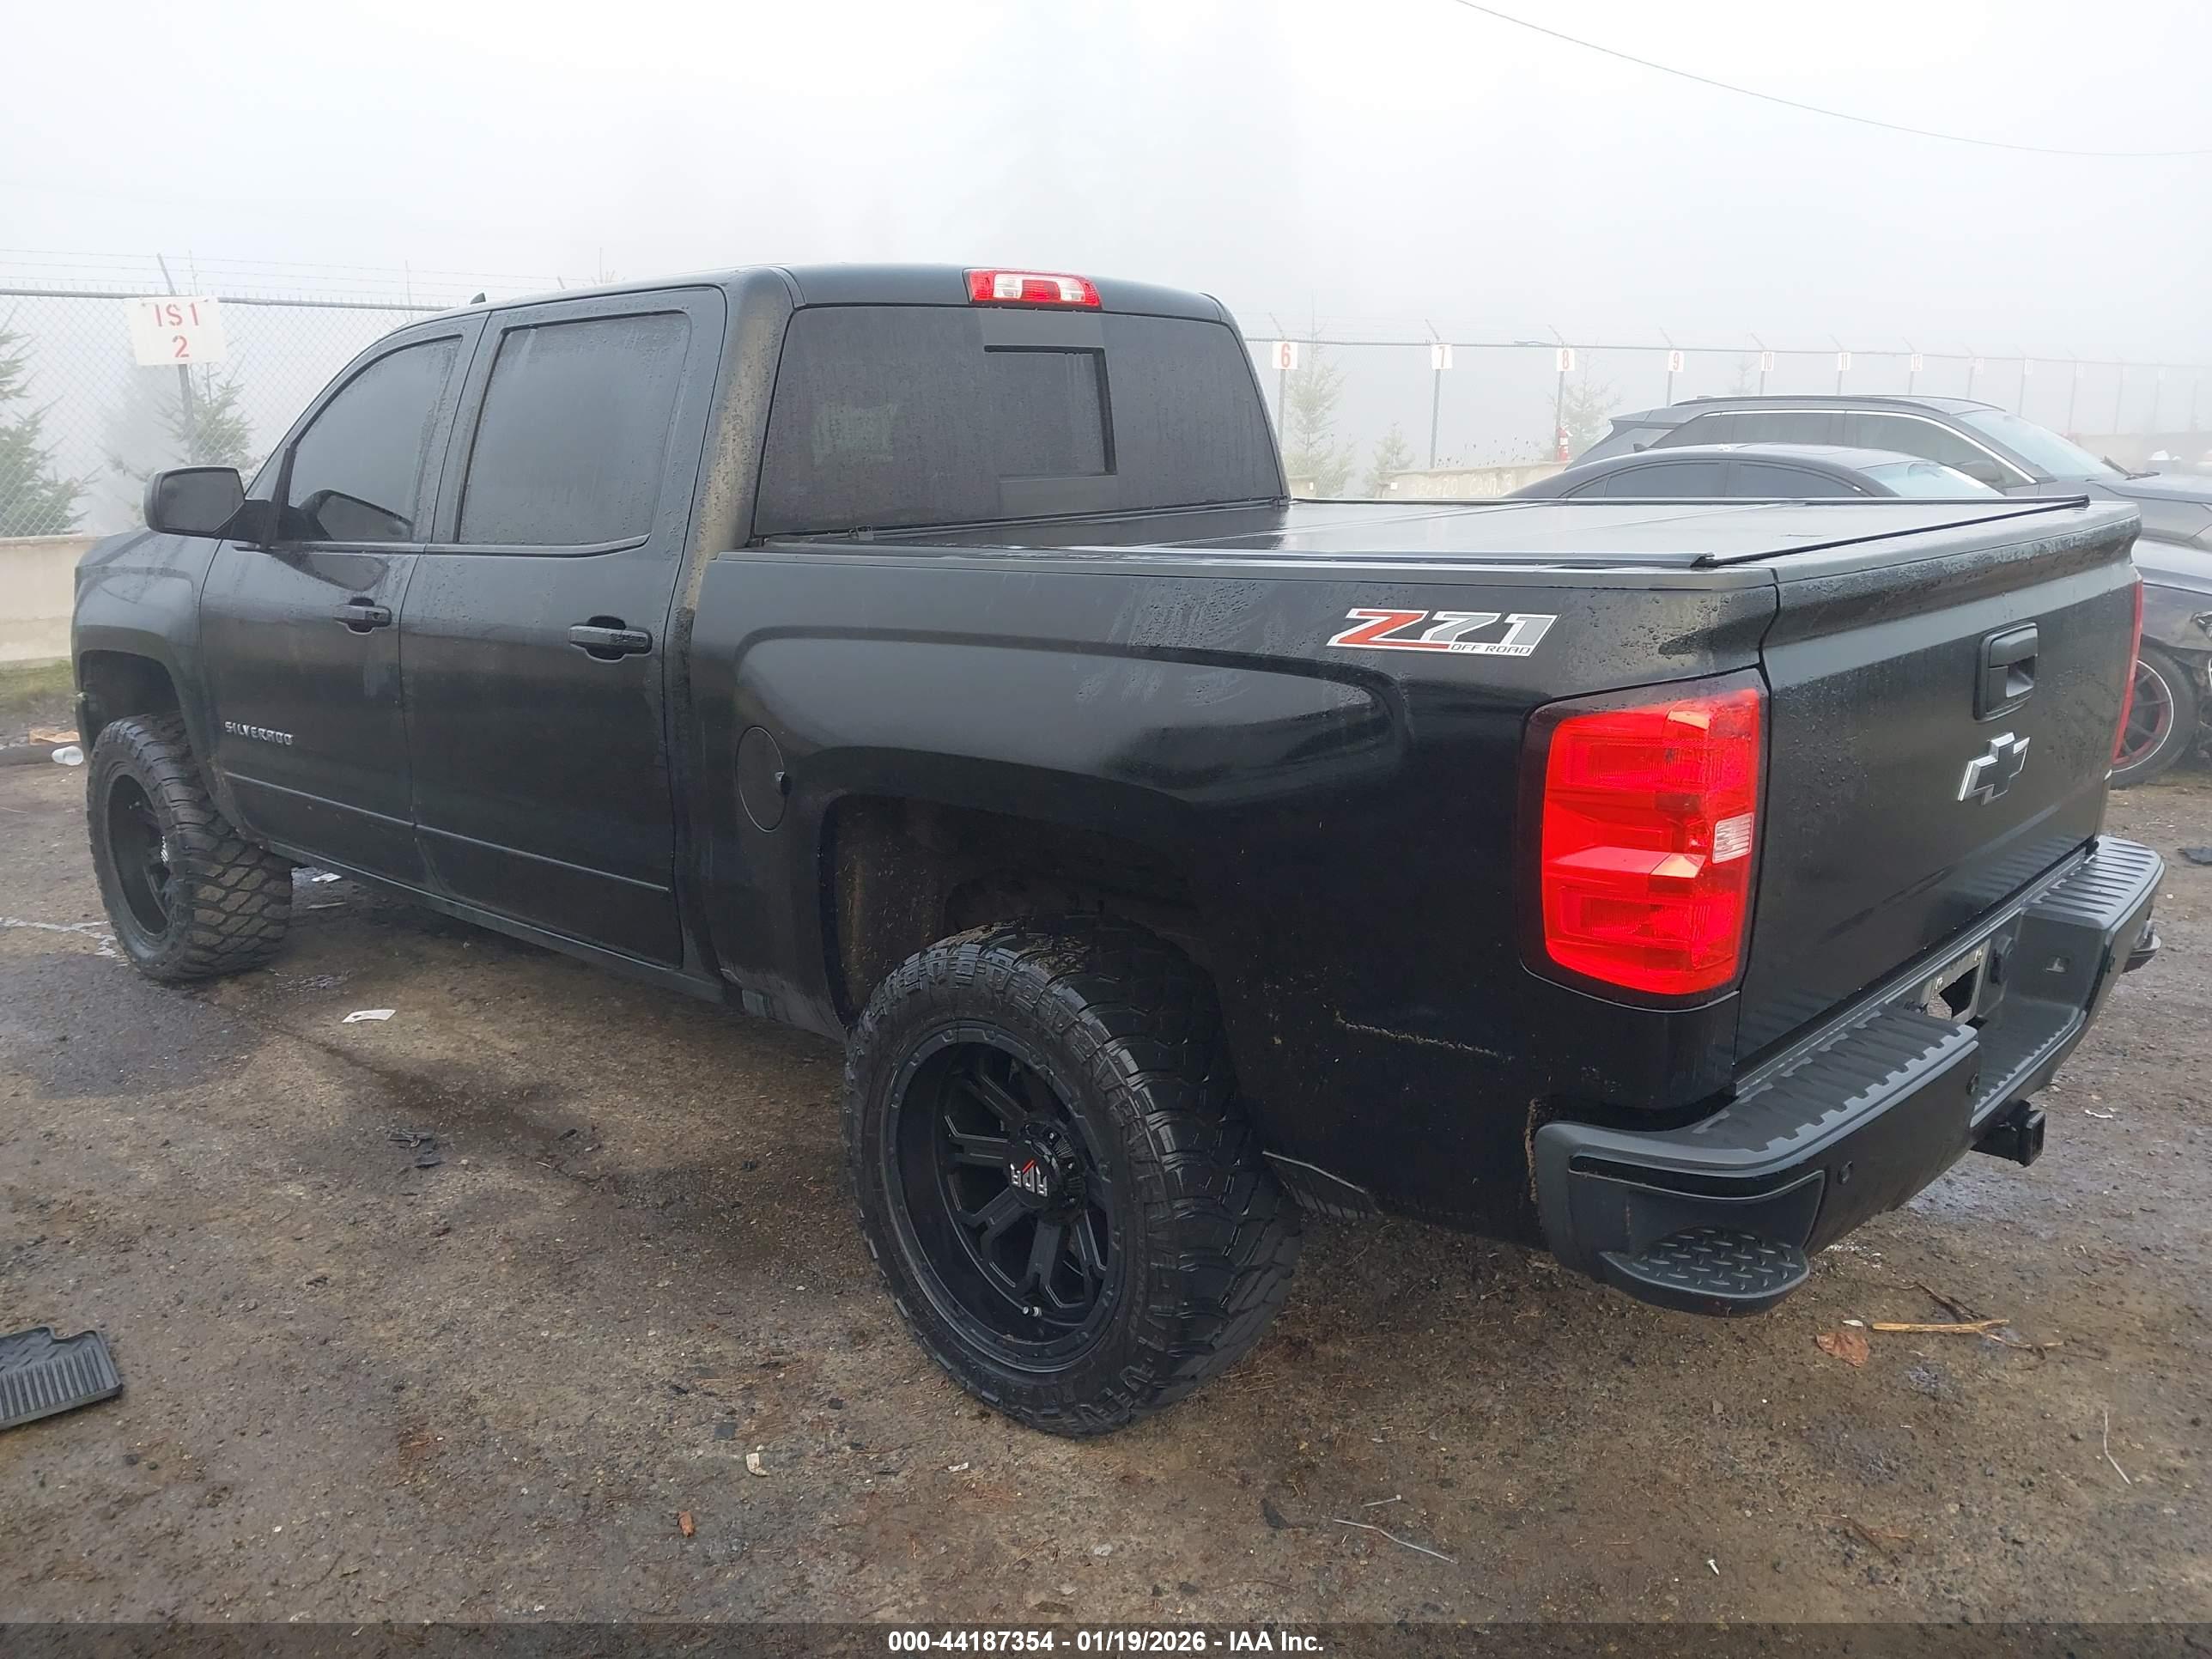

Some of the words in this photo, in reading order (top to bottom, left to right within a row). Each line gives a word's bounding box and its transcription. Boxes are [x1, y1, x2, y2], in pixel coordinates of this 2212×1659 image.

[172, 335, 190, 358] 2
[1280, 343, 1291, 368] 6
[1438, 345, 1446, 368] 7
[1562, 349, 1570, 370] 8
[1673, 352, 1680, 371] 9
[1763, 353, 1773, 370] 10
[1840, 354, 1848, 370] 11
[1326, 607, 1559, 655] Z71
[1450, 643, 1484, 653] OFF
[1489, 644, 1530, 655] ROAD
[224, 720, 294, 746] SILVERADO
